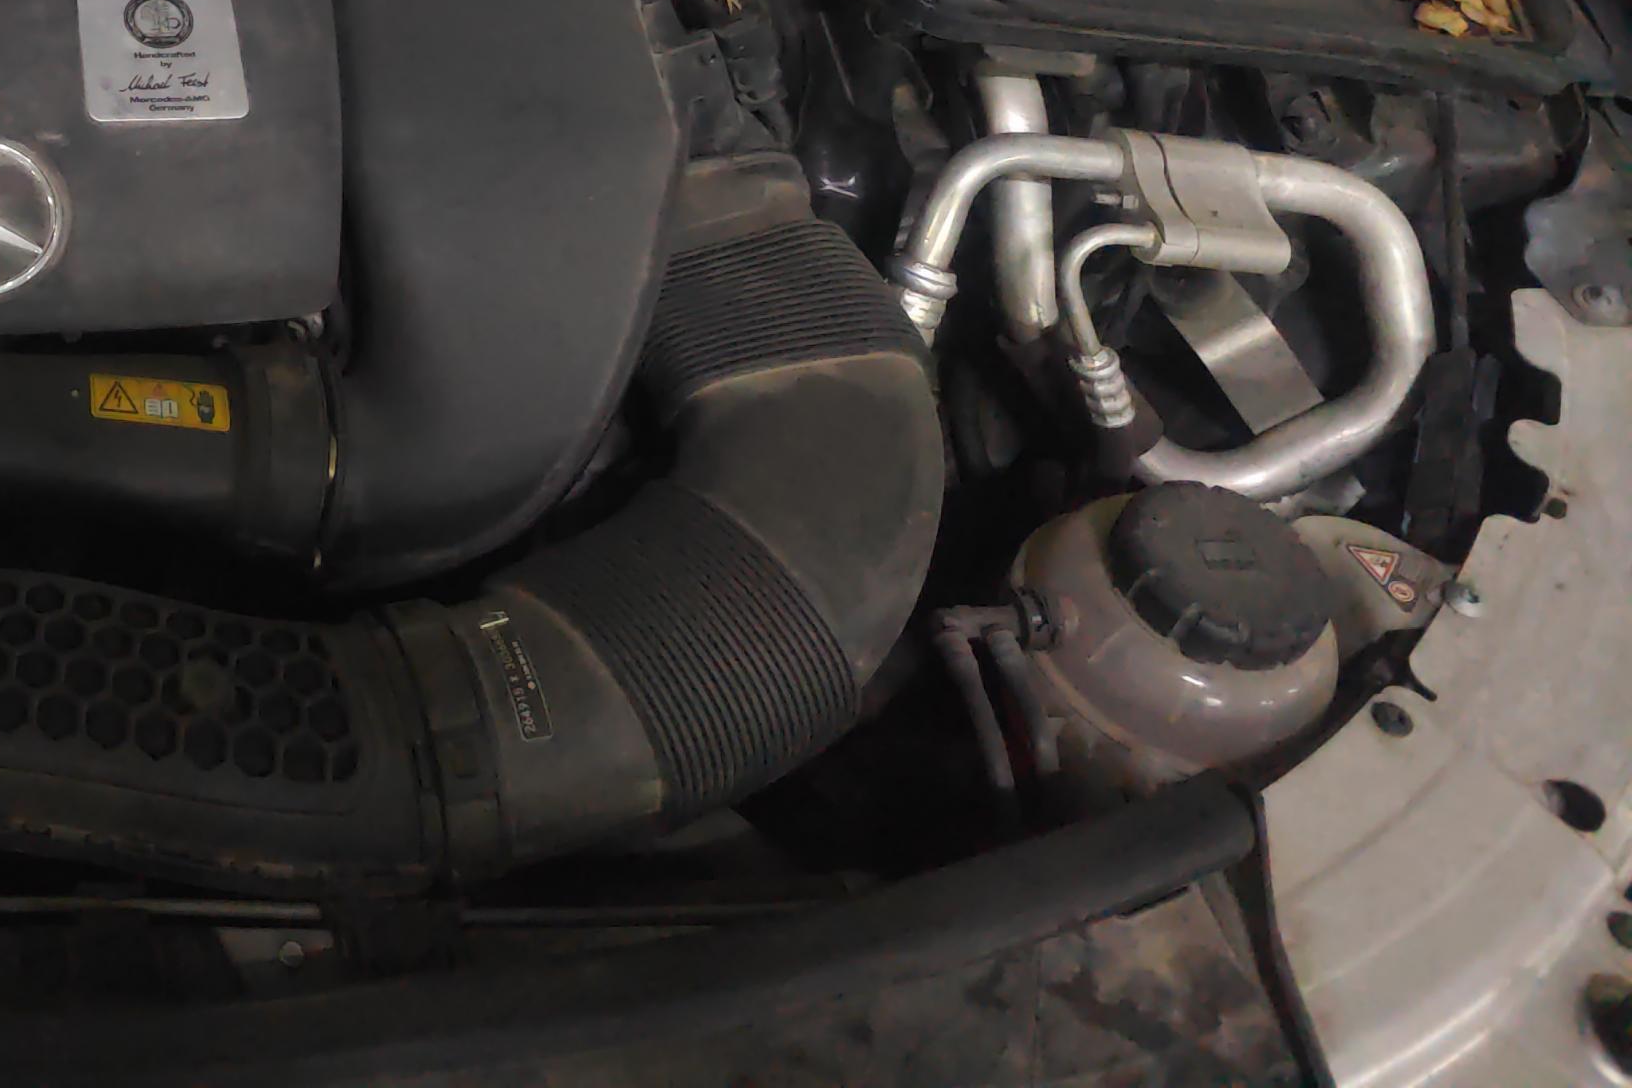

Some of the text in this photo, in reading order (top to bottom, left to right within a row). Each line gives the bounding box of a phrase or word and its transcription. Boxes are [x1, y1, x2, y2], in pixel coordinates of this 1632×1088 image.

[134, 51, 196, 59] Handcrafted
[160, 60, 173, 69] by
[149, 104, 195, 112] Germany
